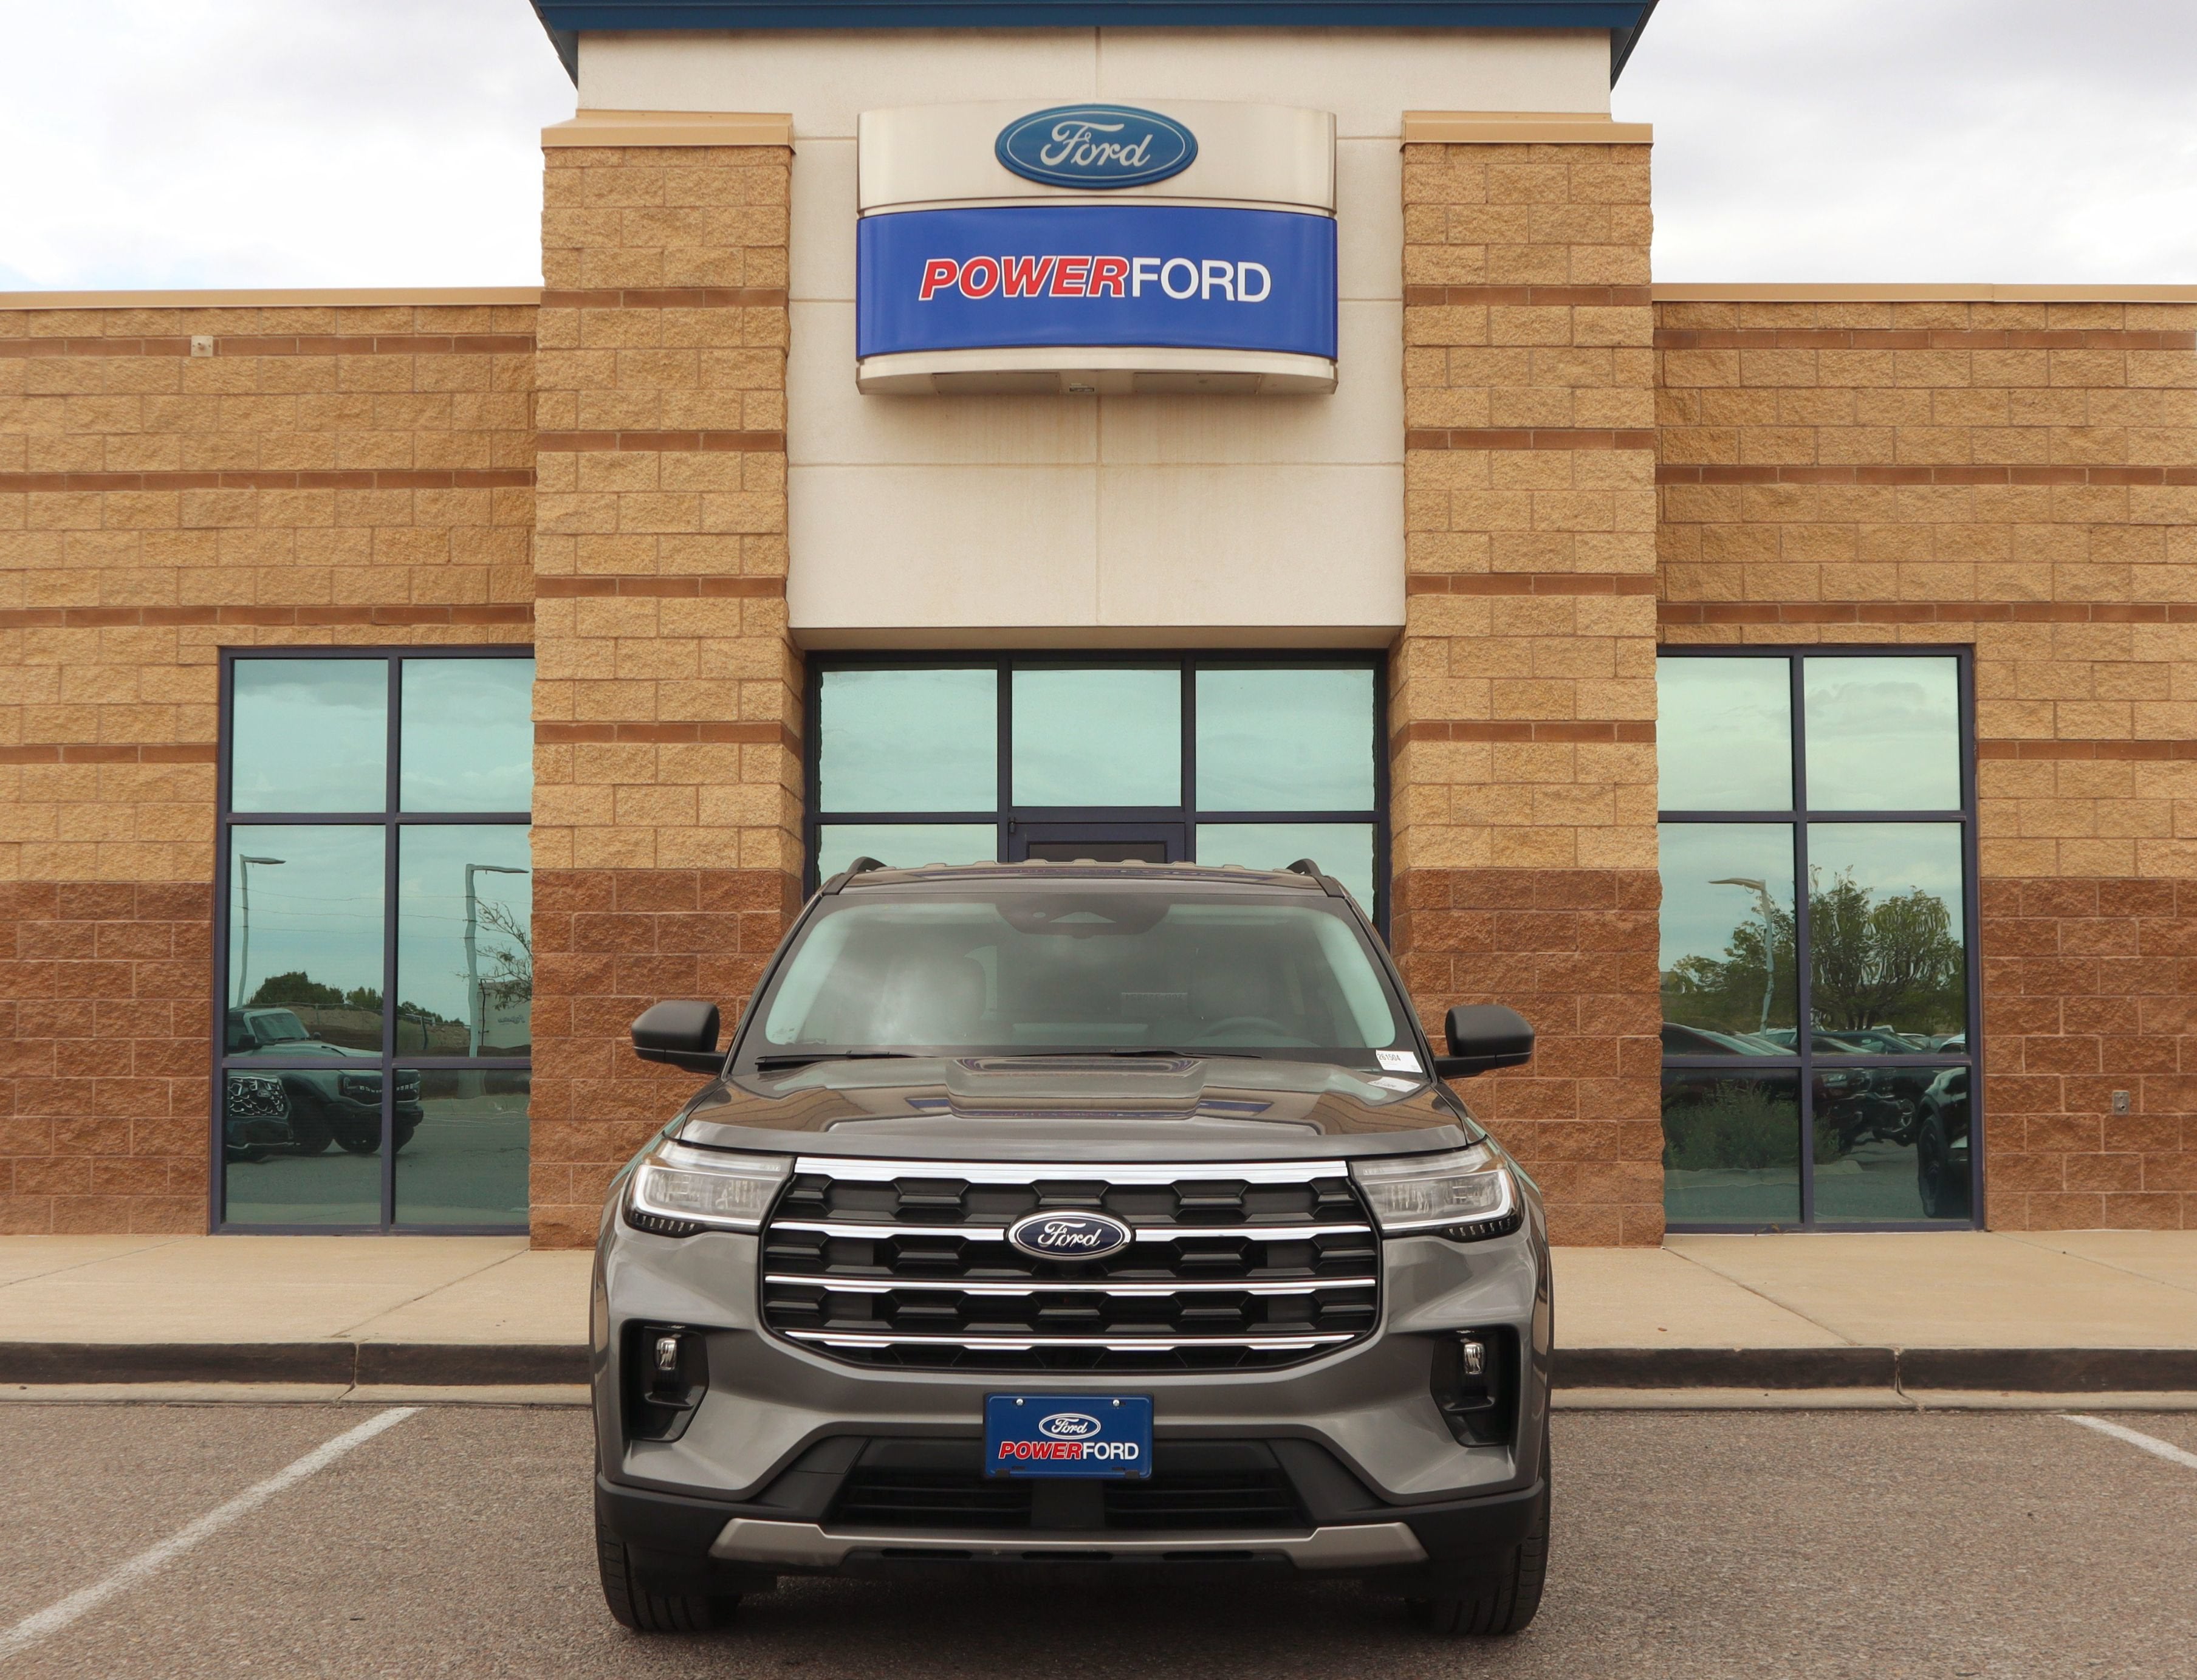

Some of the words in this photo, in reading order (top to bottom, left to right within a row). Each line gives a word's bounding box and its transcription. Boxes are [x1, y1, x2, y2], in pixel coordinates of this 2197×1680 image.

[1040, 120, 1152, 168] Ford
[1037, 1221, 1103, 1247] Ford
[1051, 1418, 1088, 1434] Ford
